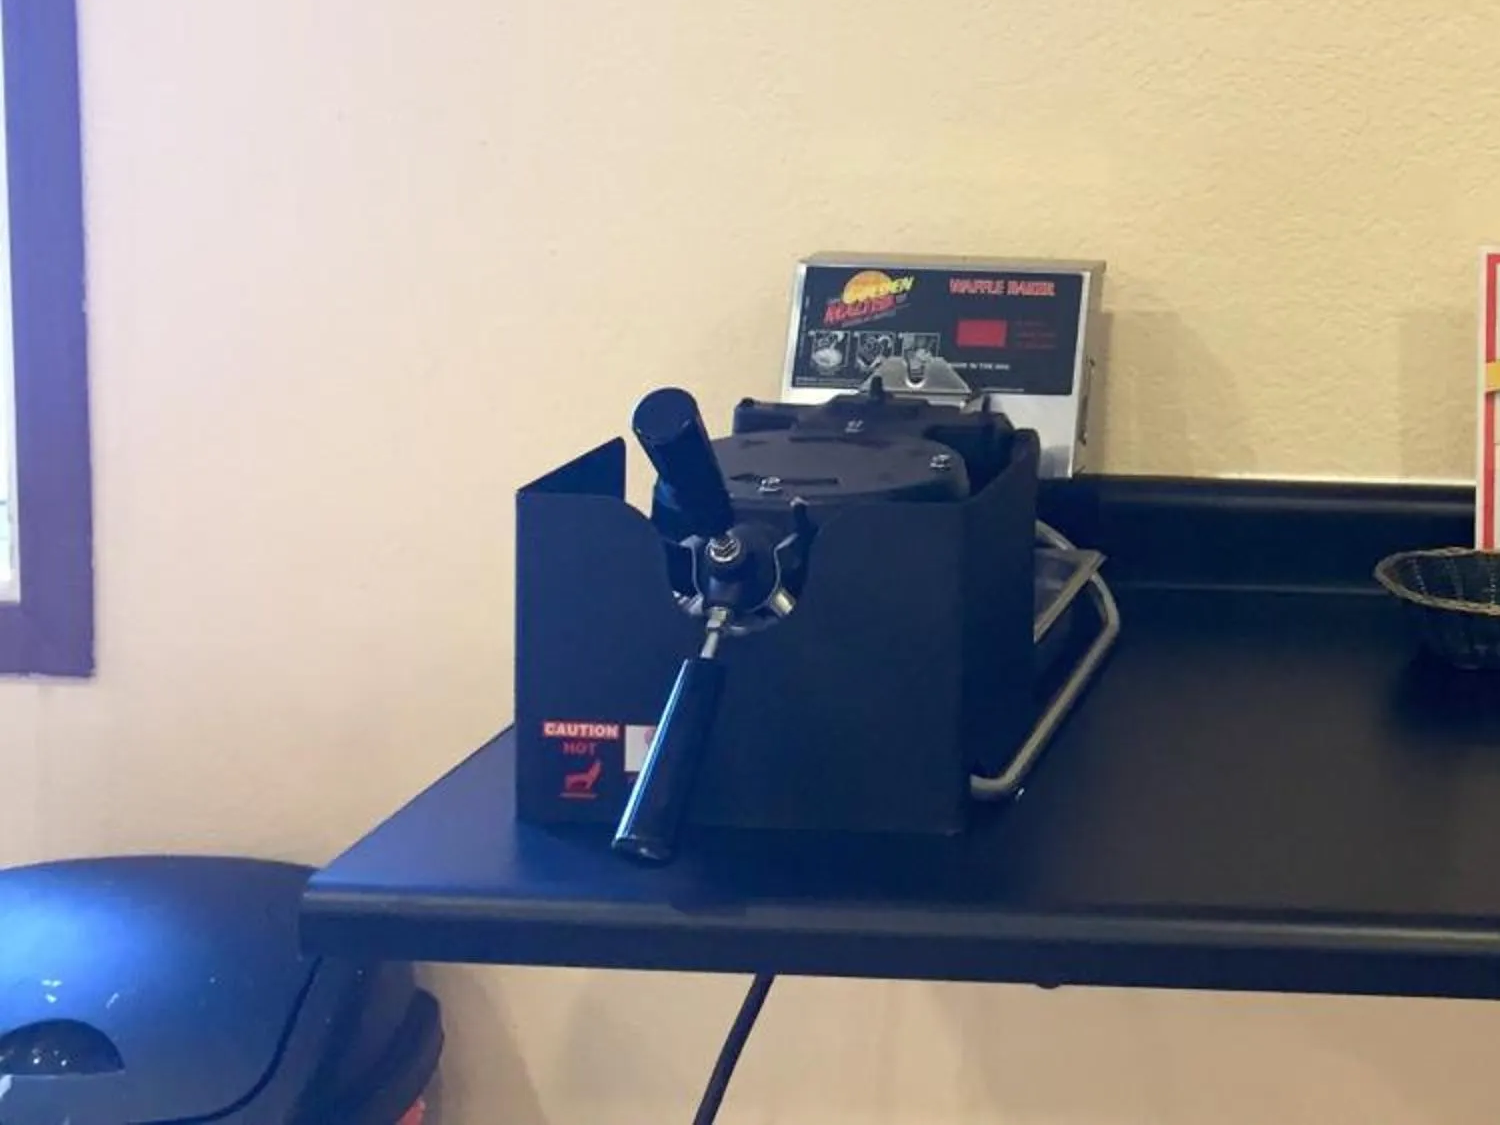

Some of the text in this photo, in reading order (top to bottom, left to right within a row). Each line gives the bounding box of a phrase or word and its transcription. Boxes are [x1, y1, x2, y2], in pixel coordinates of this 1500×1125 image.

[949, 278, 1055, 296] WAFFLE BAKER
[543, 721, 620, 739] CAUTION
[562, 741, 597, 755] HOT
